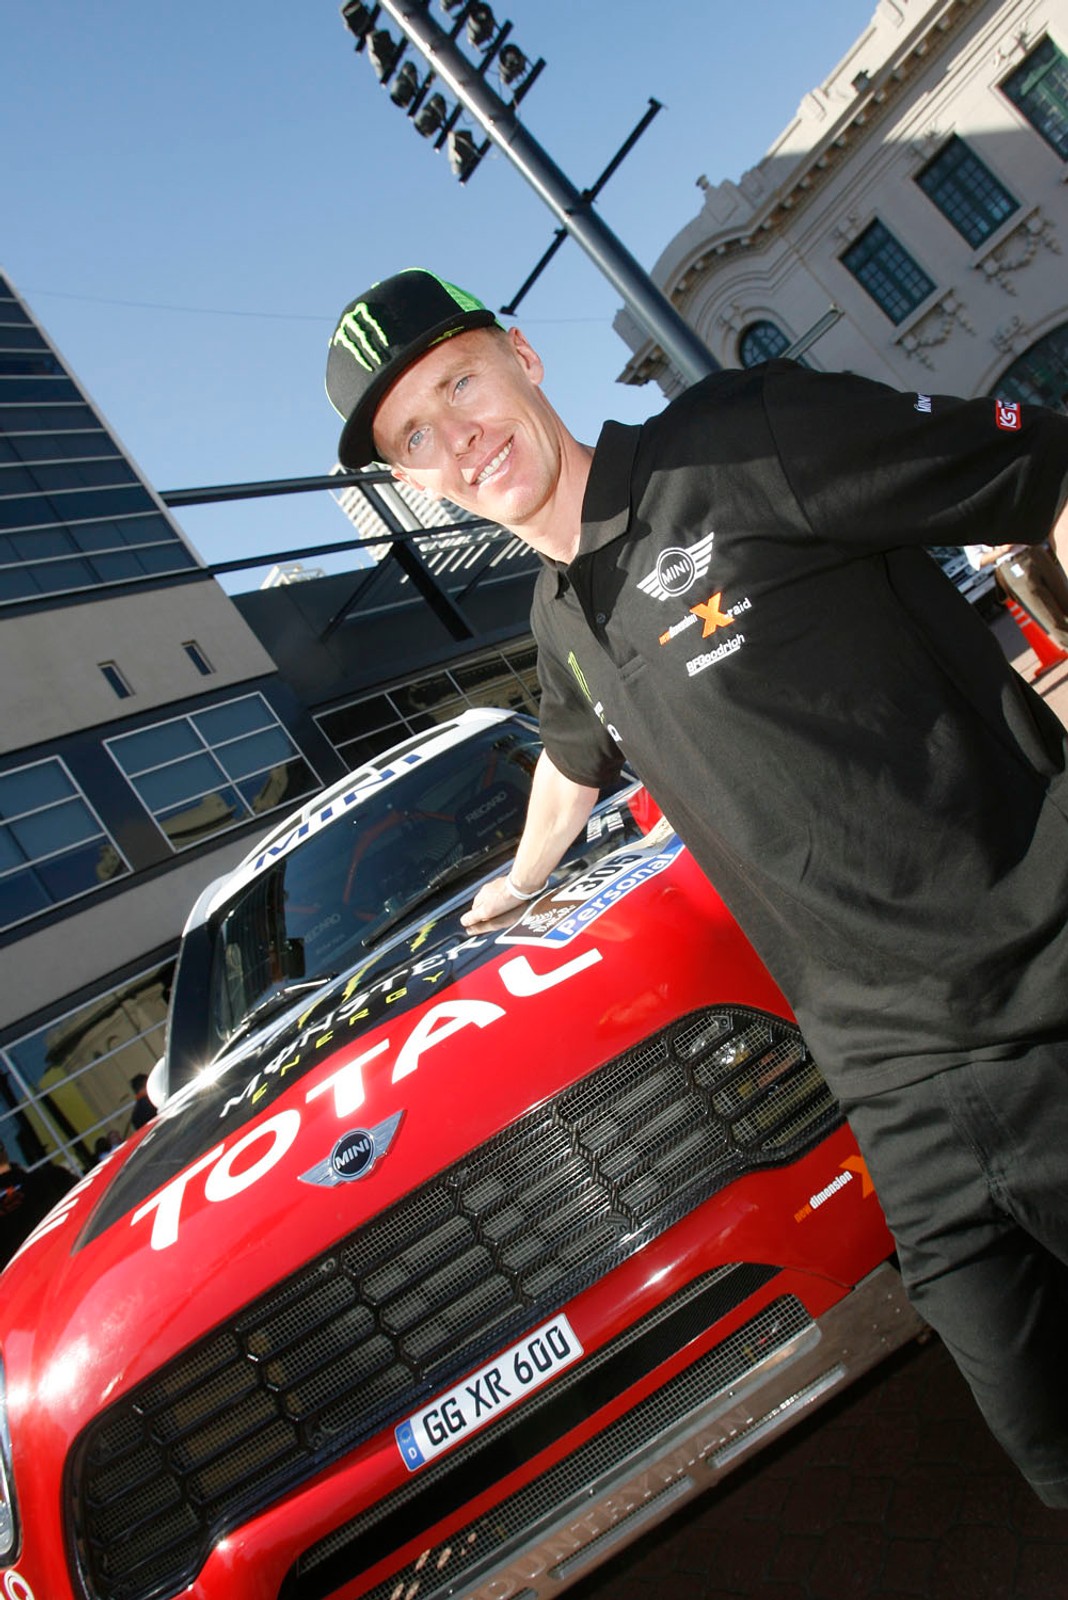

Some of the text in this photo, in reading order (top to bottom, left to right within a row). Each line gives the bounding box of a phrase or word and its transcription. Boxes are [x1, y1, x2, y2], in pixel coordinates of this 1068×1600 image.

[661, 558, 690, 585] MINI
[685, 633, 746, 674] BFGoodrich
[254, 753, 423, 871] MINI
[556, 853, 675, 936] Personal
[219, 935, 488, 1118] MONSTER
[251, 970, 445, 1105] ENERGY
[129, 947, 604, 1251] TOTAL
[334, 1138, 371, 1170] MINI
[422, 1325, 571, 1446] GG XR 600
[408, 1446, 418, 1461] D
[464, 1402, 755, 1600] OUNTRYMAN
